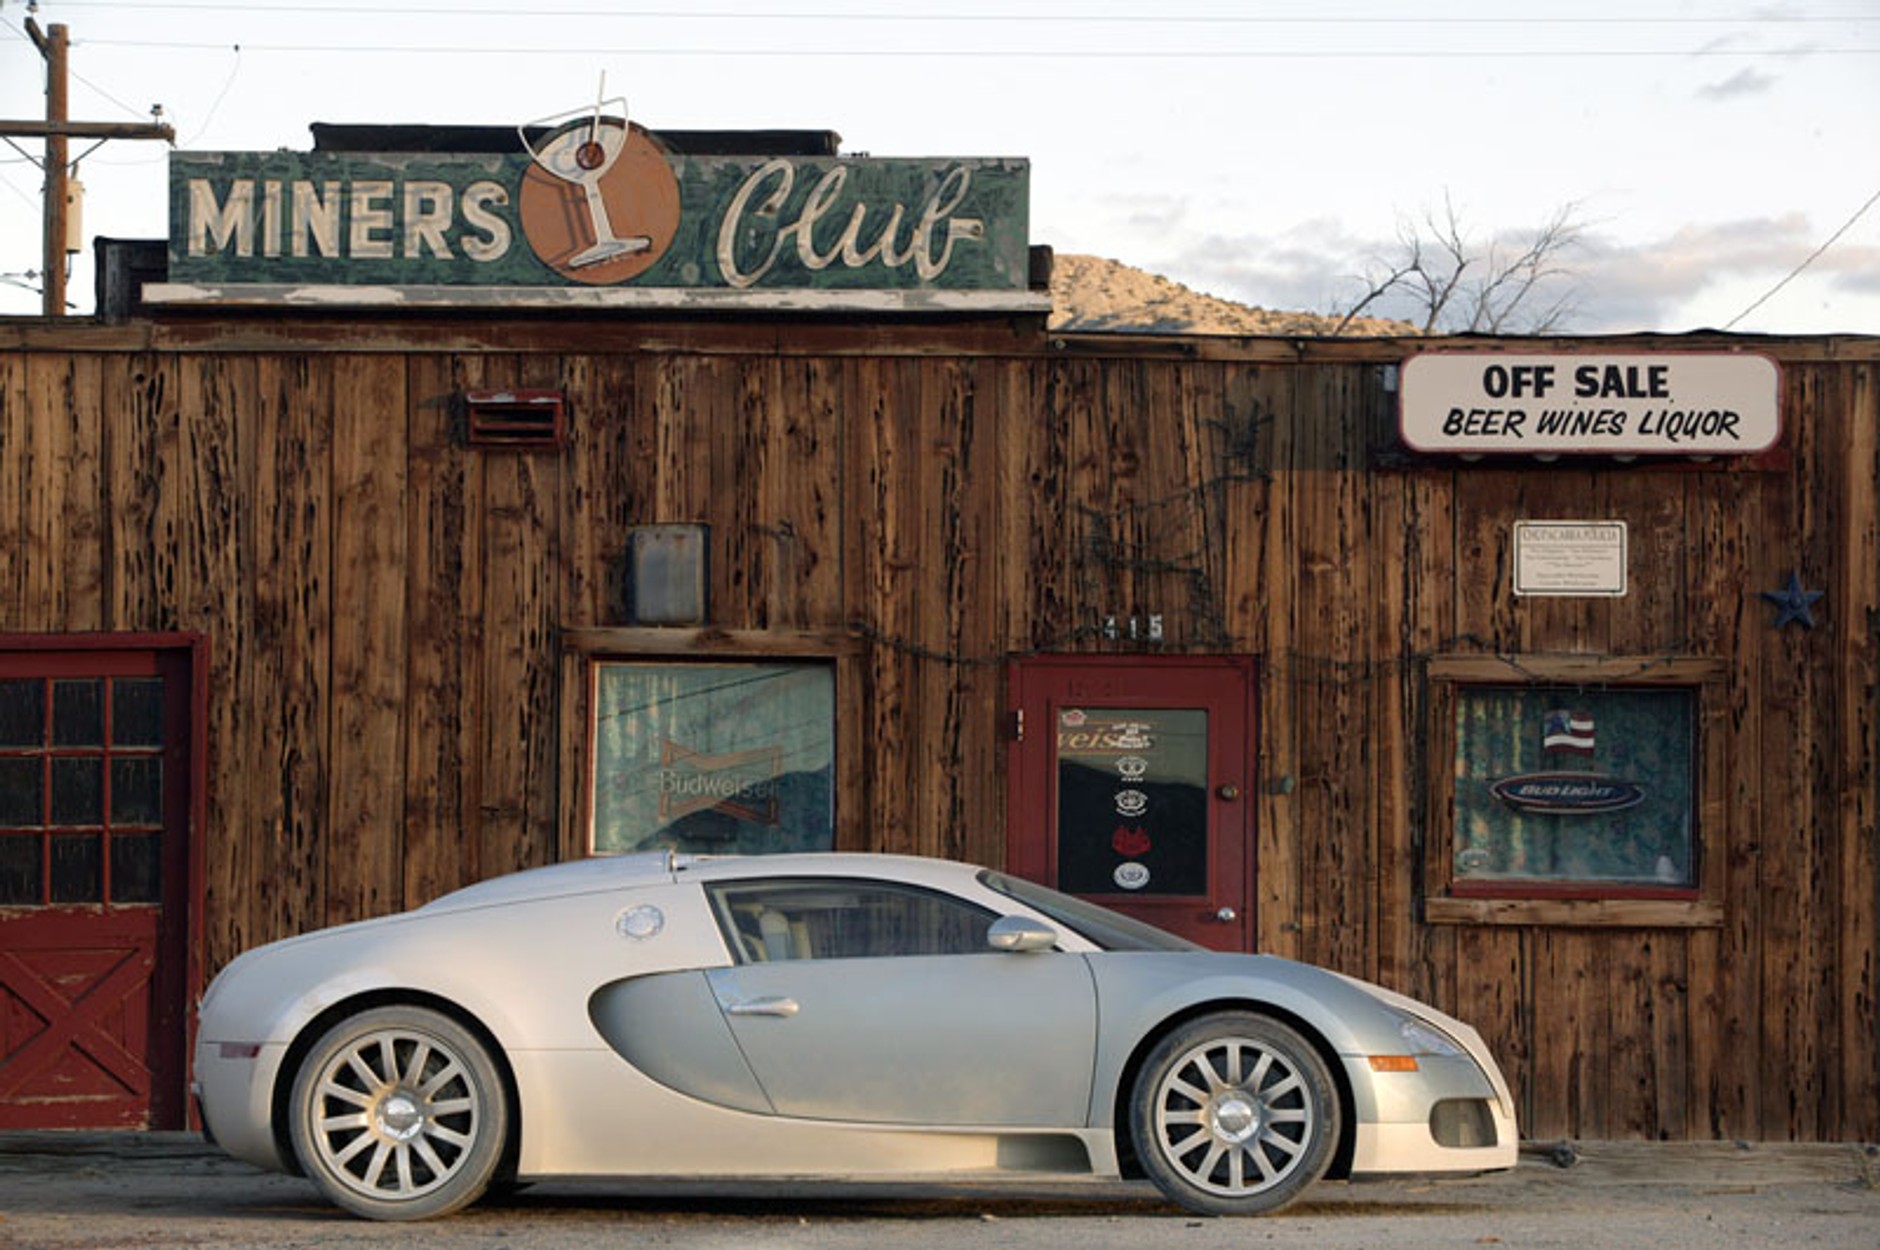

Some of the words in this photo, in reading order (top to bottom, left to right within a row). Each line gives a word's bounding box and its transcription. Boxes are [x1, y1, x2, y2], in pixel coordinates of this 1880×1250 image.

[187, 179, 511, 262] MINERS
[716, 159, 984, 288] Club
[1483, 365, 1554, 398] OFF
[1575, 365, 1669, 398] SALE
[1442, 408, 1526, 438] BEER
[1536, 411, 1627, 436] WINES
[1638, 410, 1740, 442] LIQUOR
[1104, 614, 1162, 639] 415
[1519, 784, 1560, 796] BUD
